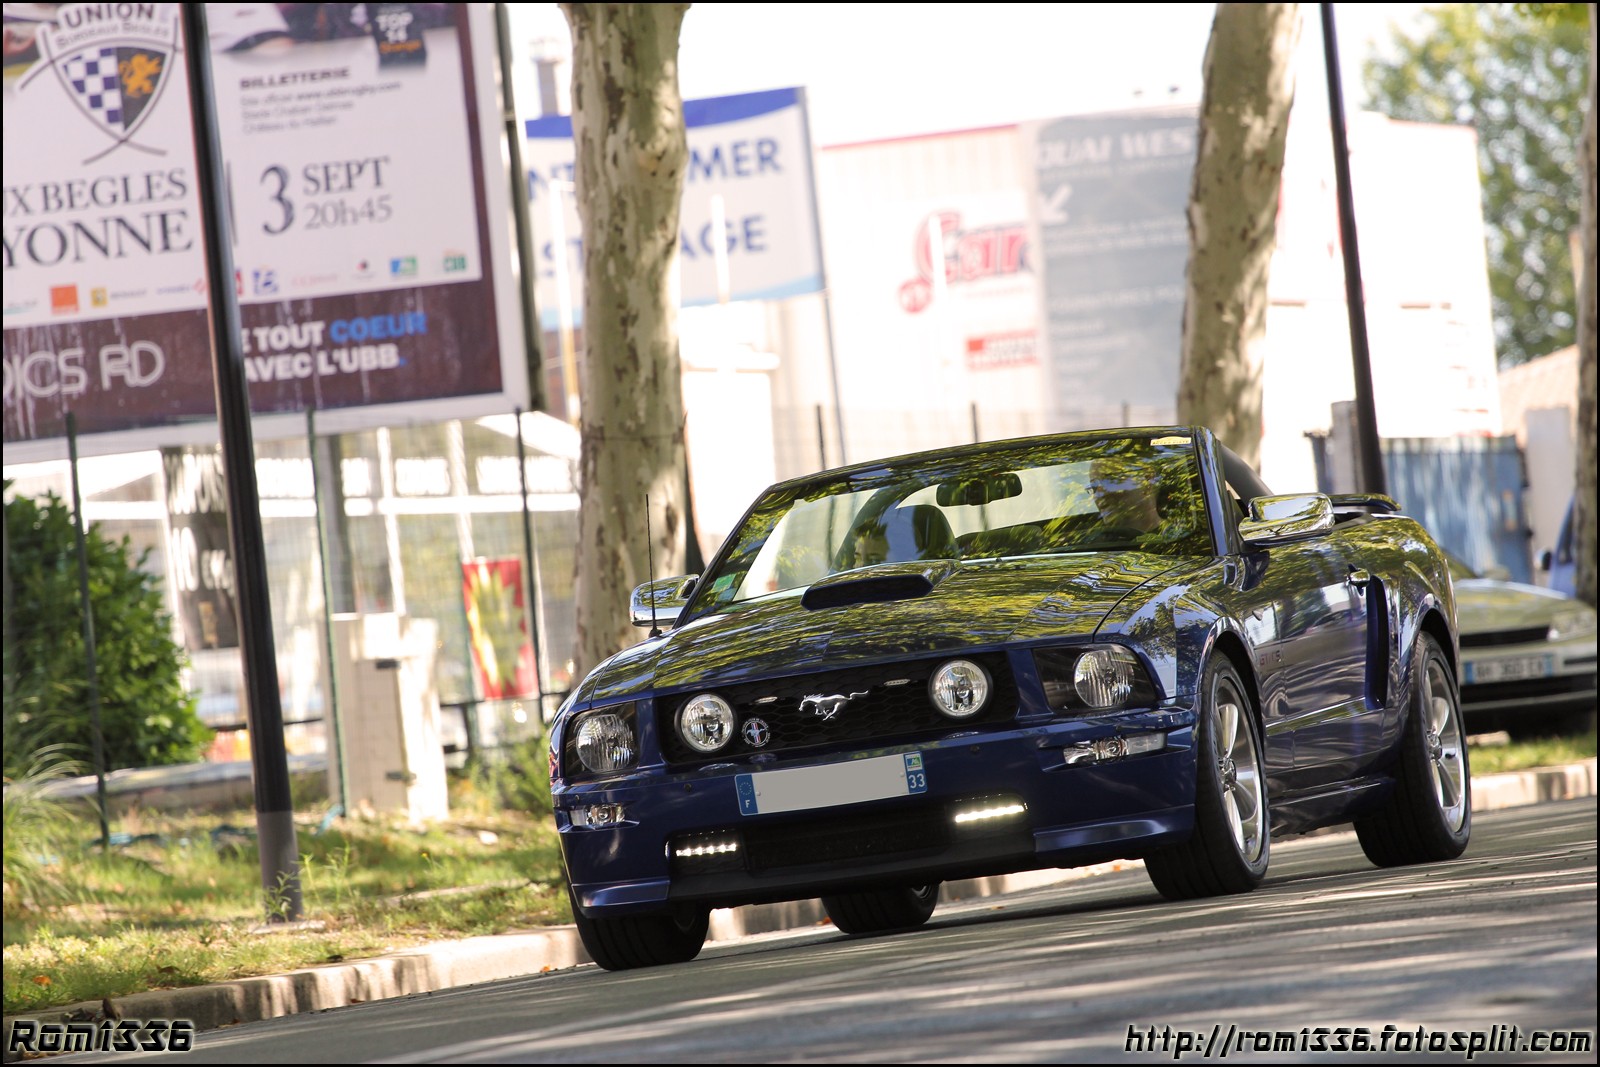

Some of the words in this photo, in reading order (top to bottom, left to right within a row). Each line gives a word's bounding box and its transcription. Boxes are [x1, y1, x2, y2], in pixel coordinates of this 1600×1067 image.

[64, 3, 154, 28] UNION
[4, 184, 35, 218] X
[40, 166, 188, 213] BEGLES
[259, 165, 295, 236] 3
[302, 155, 391, 196] SEPT
[303, 195, 393, 230] 20h45
[253, 320, 326, 351] TOUT
[329, 312, 427, 343] COEUR
[244, 351, 313, 383] AVEC
[908, 773, 925, 789] 33
[745, 799, 751, 809] F
